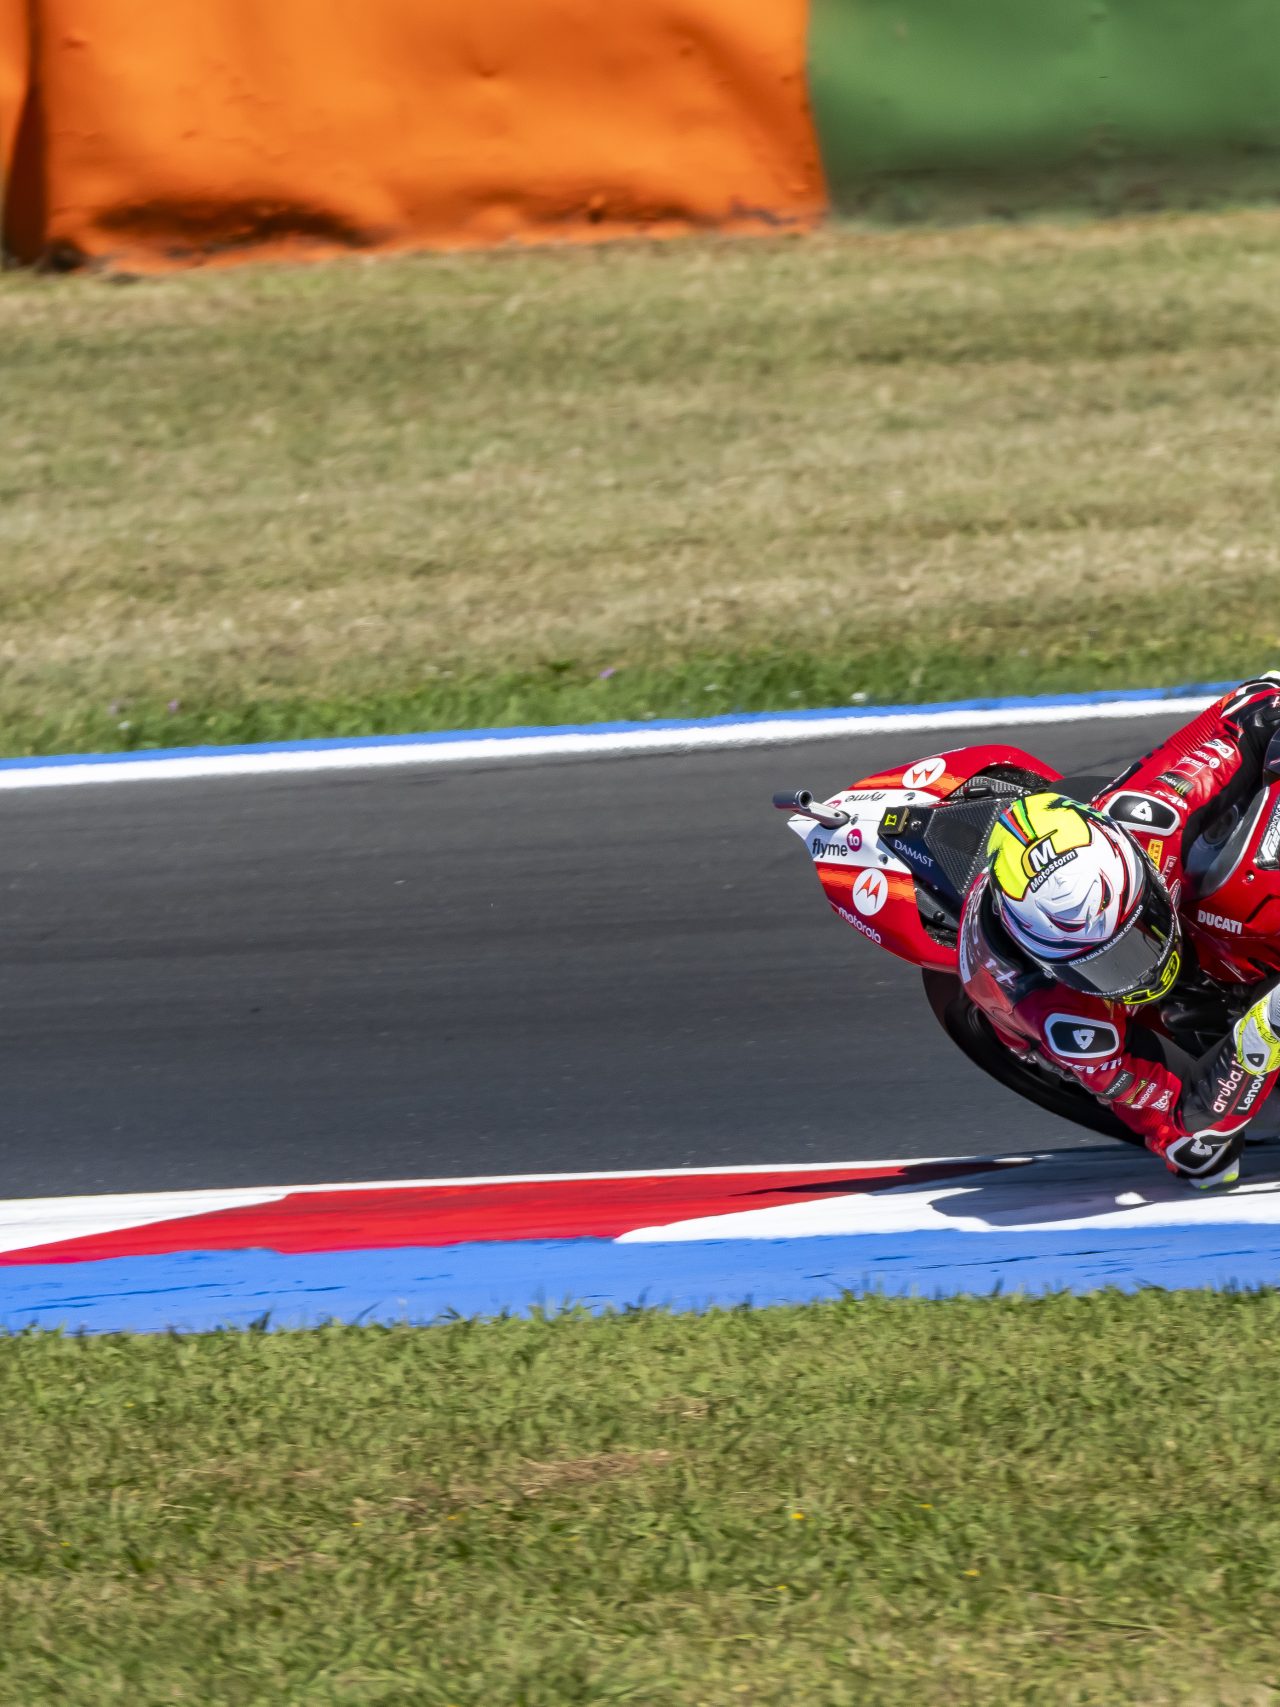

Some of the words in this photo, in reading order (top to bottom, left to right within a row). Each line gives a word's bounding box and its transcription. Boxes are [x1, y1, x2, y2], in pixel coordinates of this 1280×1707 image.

[812, 838, 848, 858] flyme
[849, 832, 861, 846] to
[894, 839, 934, 868] DAMAST
[1029, 838, 1058, 872] M
[1031, 849, 1076, 892] Motostorm
[837, 907, 882, 944] motorola
[1197, 909, 1243, 935] DUCATI
[1237, 1070, 1263, 1112] Lenov
